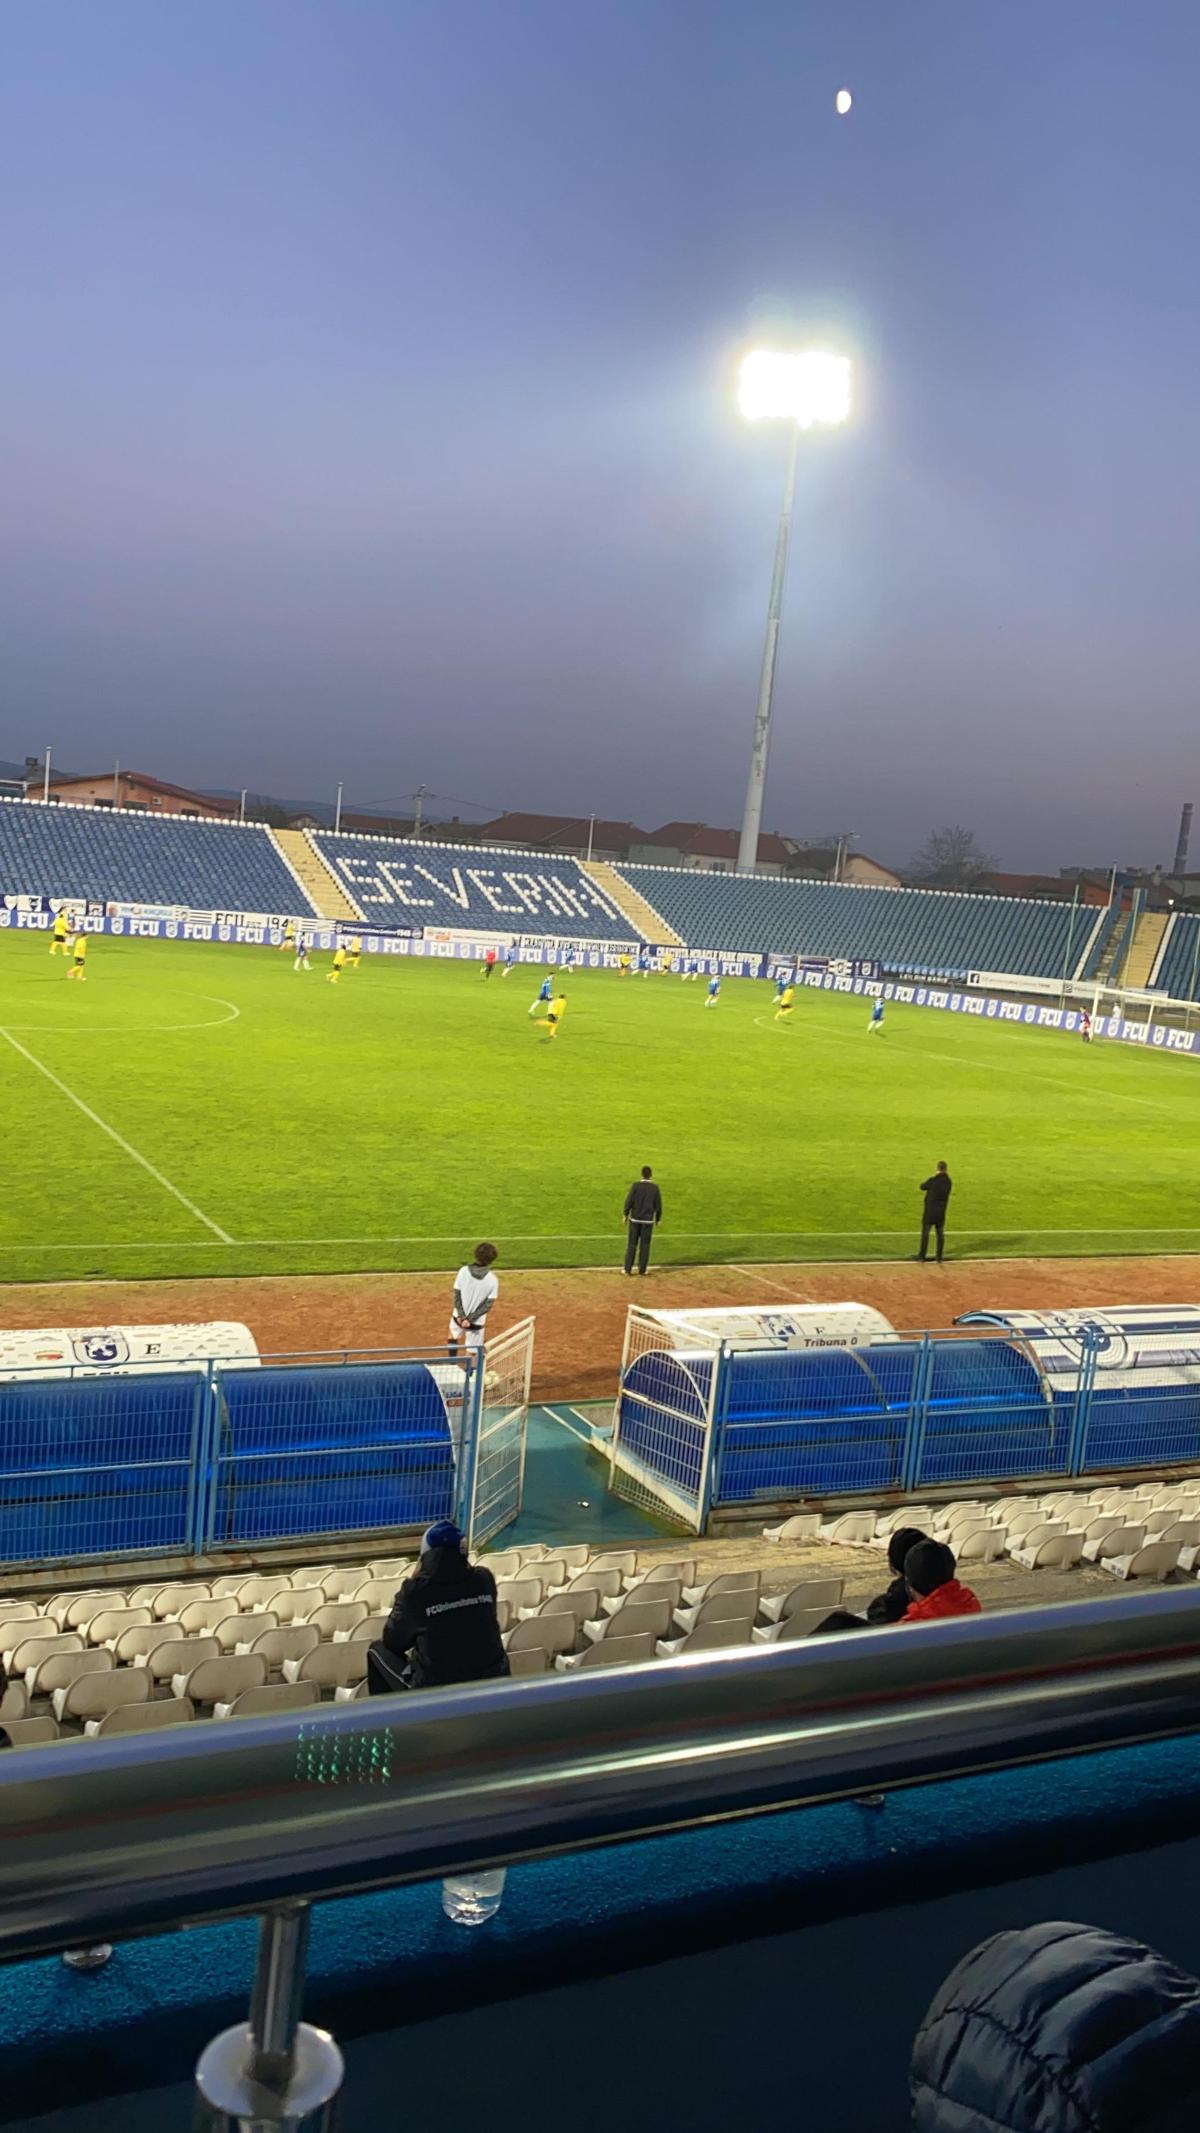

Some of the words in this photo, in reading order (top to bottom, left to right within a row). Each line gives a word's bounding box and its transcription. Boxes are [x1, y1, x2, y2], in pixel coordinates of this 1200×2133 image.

[336, 857, 617, 919] SEVERIN
[17, 912, 49, 929] FCU
[75, 916, 105, 932] FCU
[129, 919, 160, 936] FCU
[184, 923, 213, 940] FCU
[236, 926, 264, 943] FCU
[384, 938, 409, 954] FCU
[430, 941, 455, 957] FCU
[519, 948, 542, 962] FCU
[722, 962, 743, 976] FCU
[805, 971, 823, 986] FCU
[834, 976, 853, 992] FCU
[864, 980, 883, 997] FCU
[895, 985, 915, 1003] FCU
[927, 990, 949, 1008] FCU
[962, 996, 985, 1015] FCU
[1000, 1001, 1023, 1020] FCU
[1038, 1007, 1063, 1027] FCU
[1122, 1021, 1148, 1041] FCU
[1166, 1028, 1195, 1050] FCU
[804, 1338, 847, 1347] Tribuna
